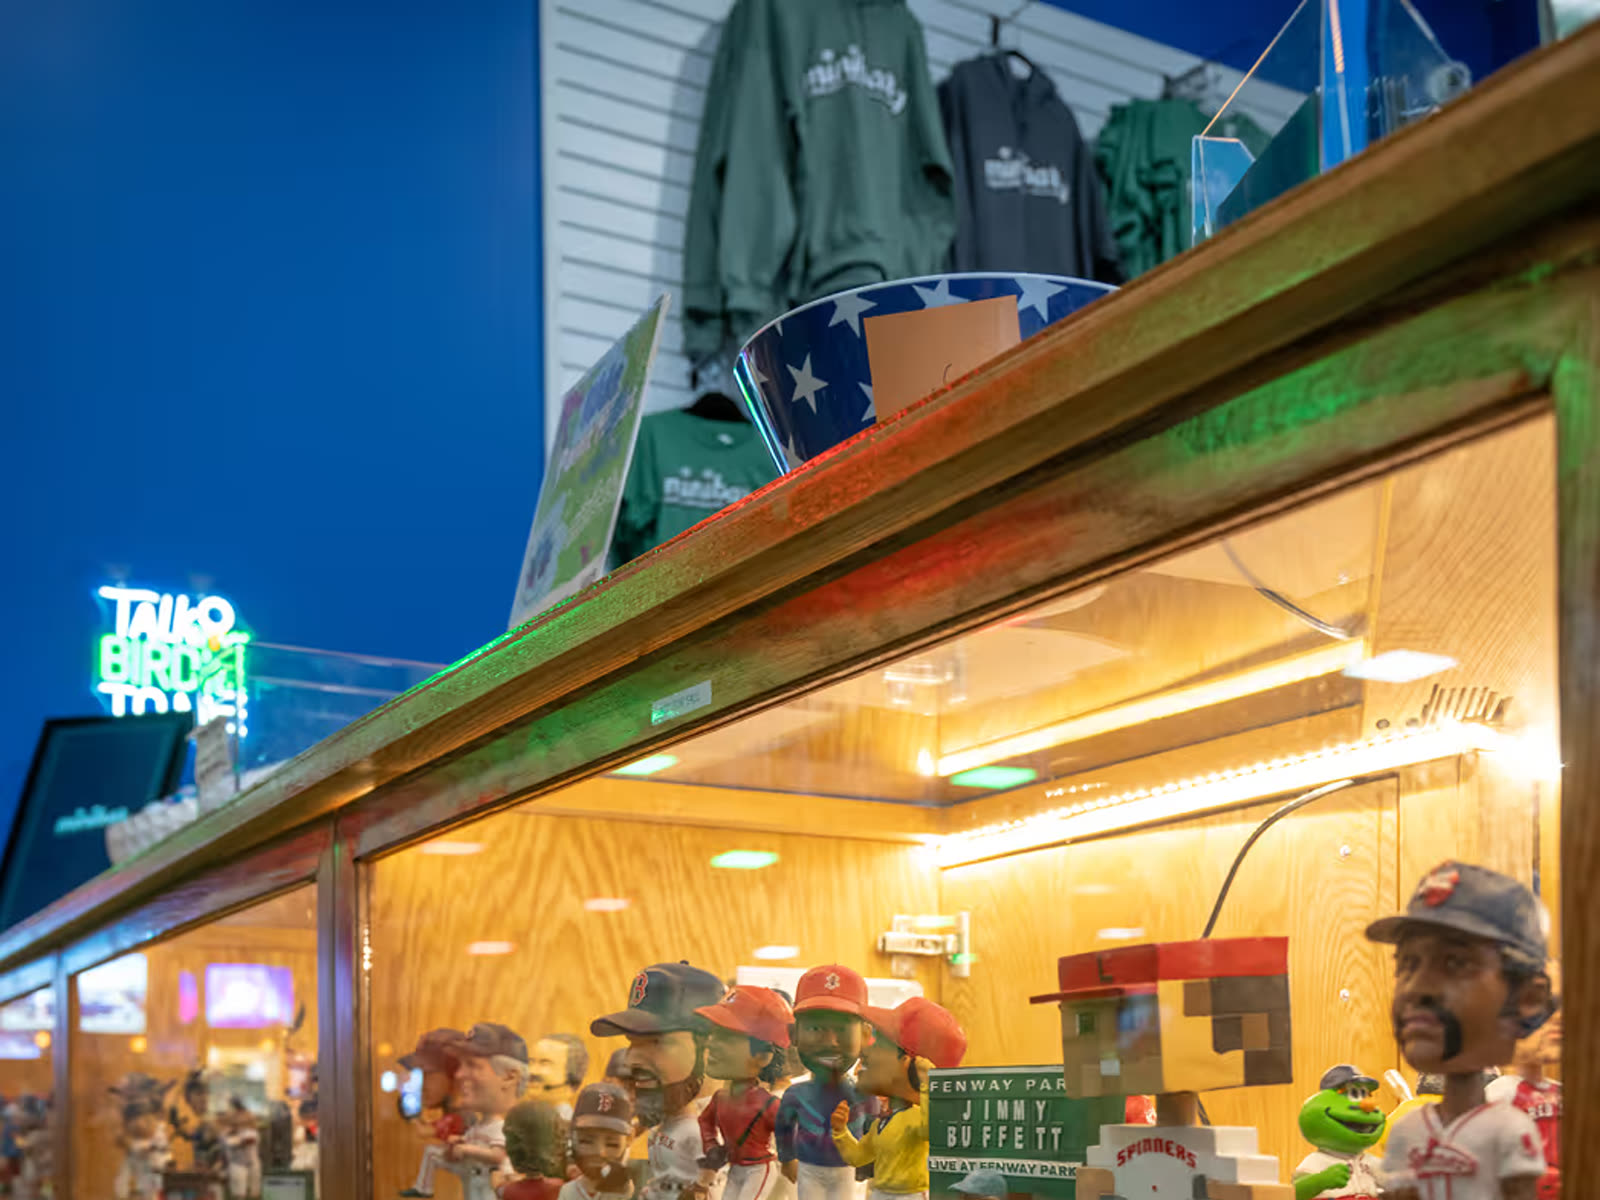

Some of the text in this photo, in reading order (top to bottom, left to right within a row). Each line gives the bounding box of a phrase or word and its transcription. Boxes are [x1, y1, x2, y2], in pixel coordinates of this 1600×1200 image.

[929, 1077, 1067, 1093] FENWAY PAR
[962, 1099, 1047, 1122] JIMMY
[946, 1125, 1063, 1151] BUFFETT
[1116, 1136, 1198, 1169] SPINNERS
[928, 1160, 957, 1172] LIVE
[960, 1161, 977, 1172] AT
[1039, 1164, 1077, 1177] PARK
